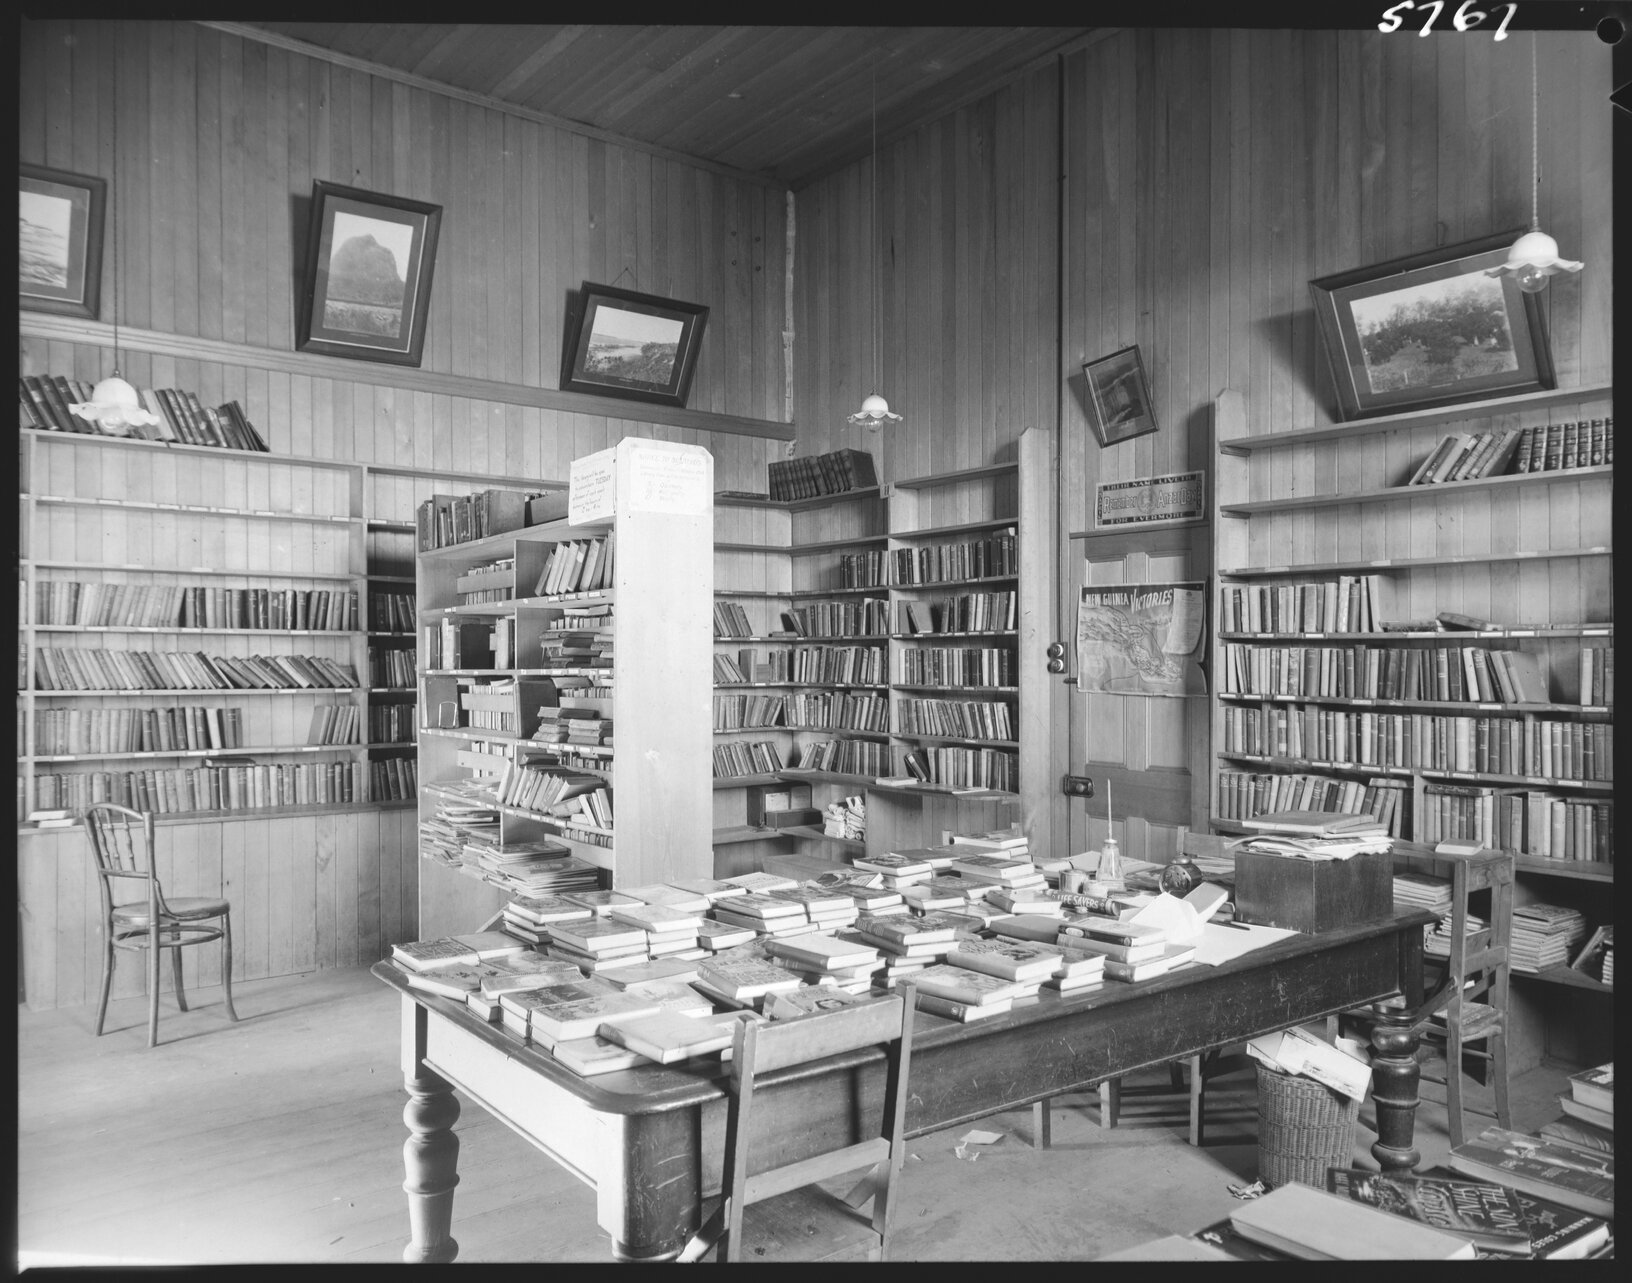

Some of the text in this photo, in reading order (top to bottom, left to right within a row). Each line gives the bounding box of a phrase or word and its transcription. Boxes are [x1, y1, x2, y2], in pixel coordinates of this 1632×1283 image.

[1103, 496, 1137, 514] Remember
[1157, 489, 1179, 507] Anzac
[1086, 588, 1173, 614] NEW GUINEA VICTORIES
[1073, 896, 1099, 909] SAVERS
[1448, 1184, 1486, 1219] SHINE
[1479, 1186, 1510, 1208] THE
